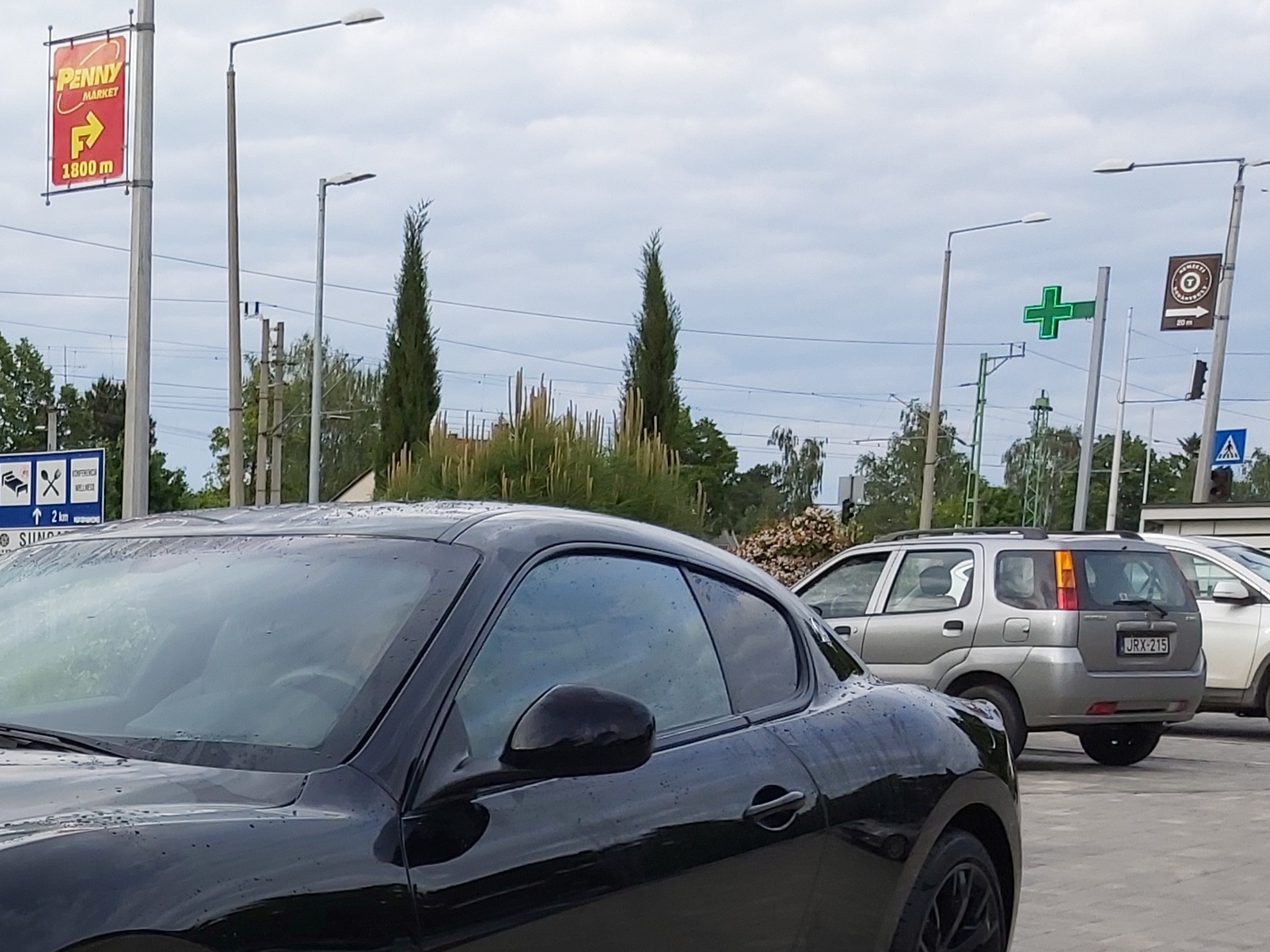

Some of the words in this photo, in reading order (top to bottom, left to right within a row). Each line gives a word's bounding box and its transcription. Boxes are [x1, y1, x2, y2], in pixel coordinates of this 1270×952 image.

[56, 61, 123, 92] PENNY
[82, 87, 119, 102] MARKET
[62, 160, 97, 179] 1800
[99, 159, 113, 174] m
[51, 509, 57, 523] 2
[58, 511, 69, 522] km
[1126, 639, 1167, 652] JRX-215
